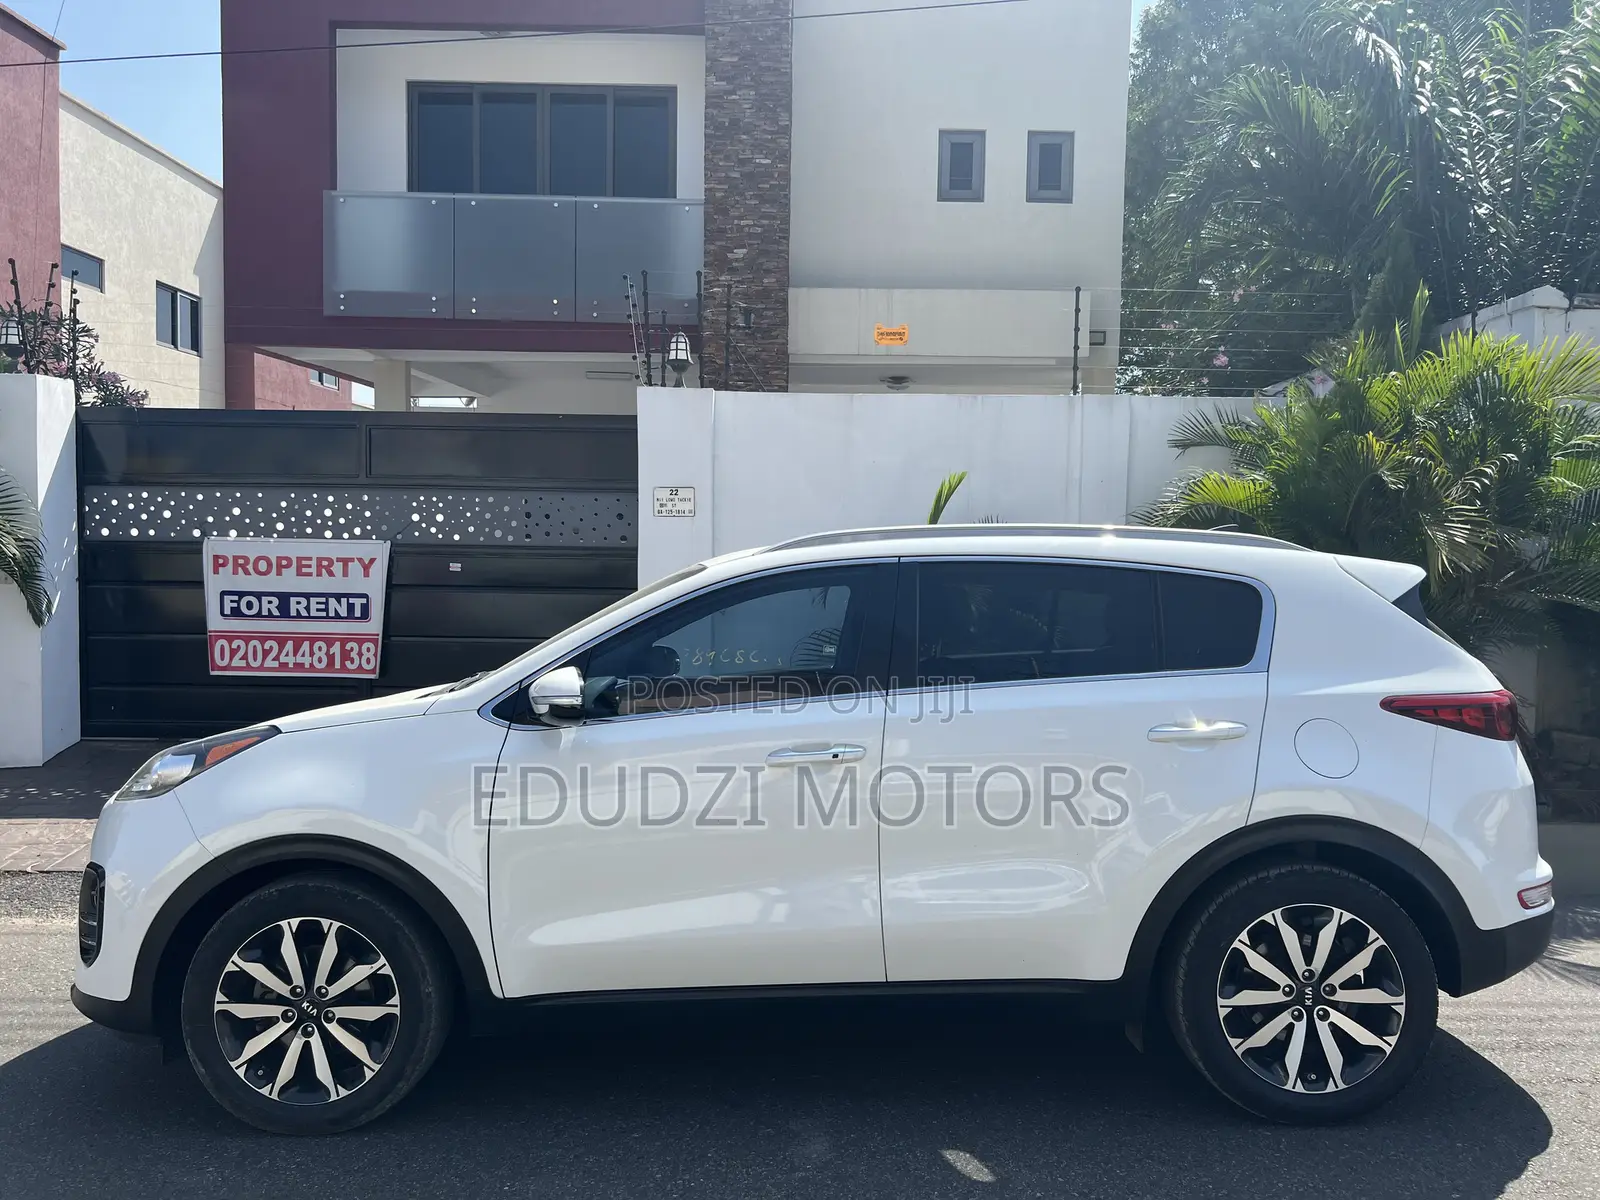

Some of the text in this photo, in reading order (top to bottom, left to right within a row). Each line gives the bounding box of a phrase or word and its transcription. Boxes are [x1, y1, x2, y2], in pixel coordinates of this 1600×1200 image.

[212, 554, 377, 578] PROPERTY
[223, 595, 367, 617] FOR RENT
[214, 639, 376, 670] 0202448138
[1304, 986, 1312, 1006] KIA
[301, 1000, 317, 1016] KIA
